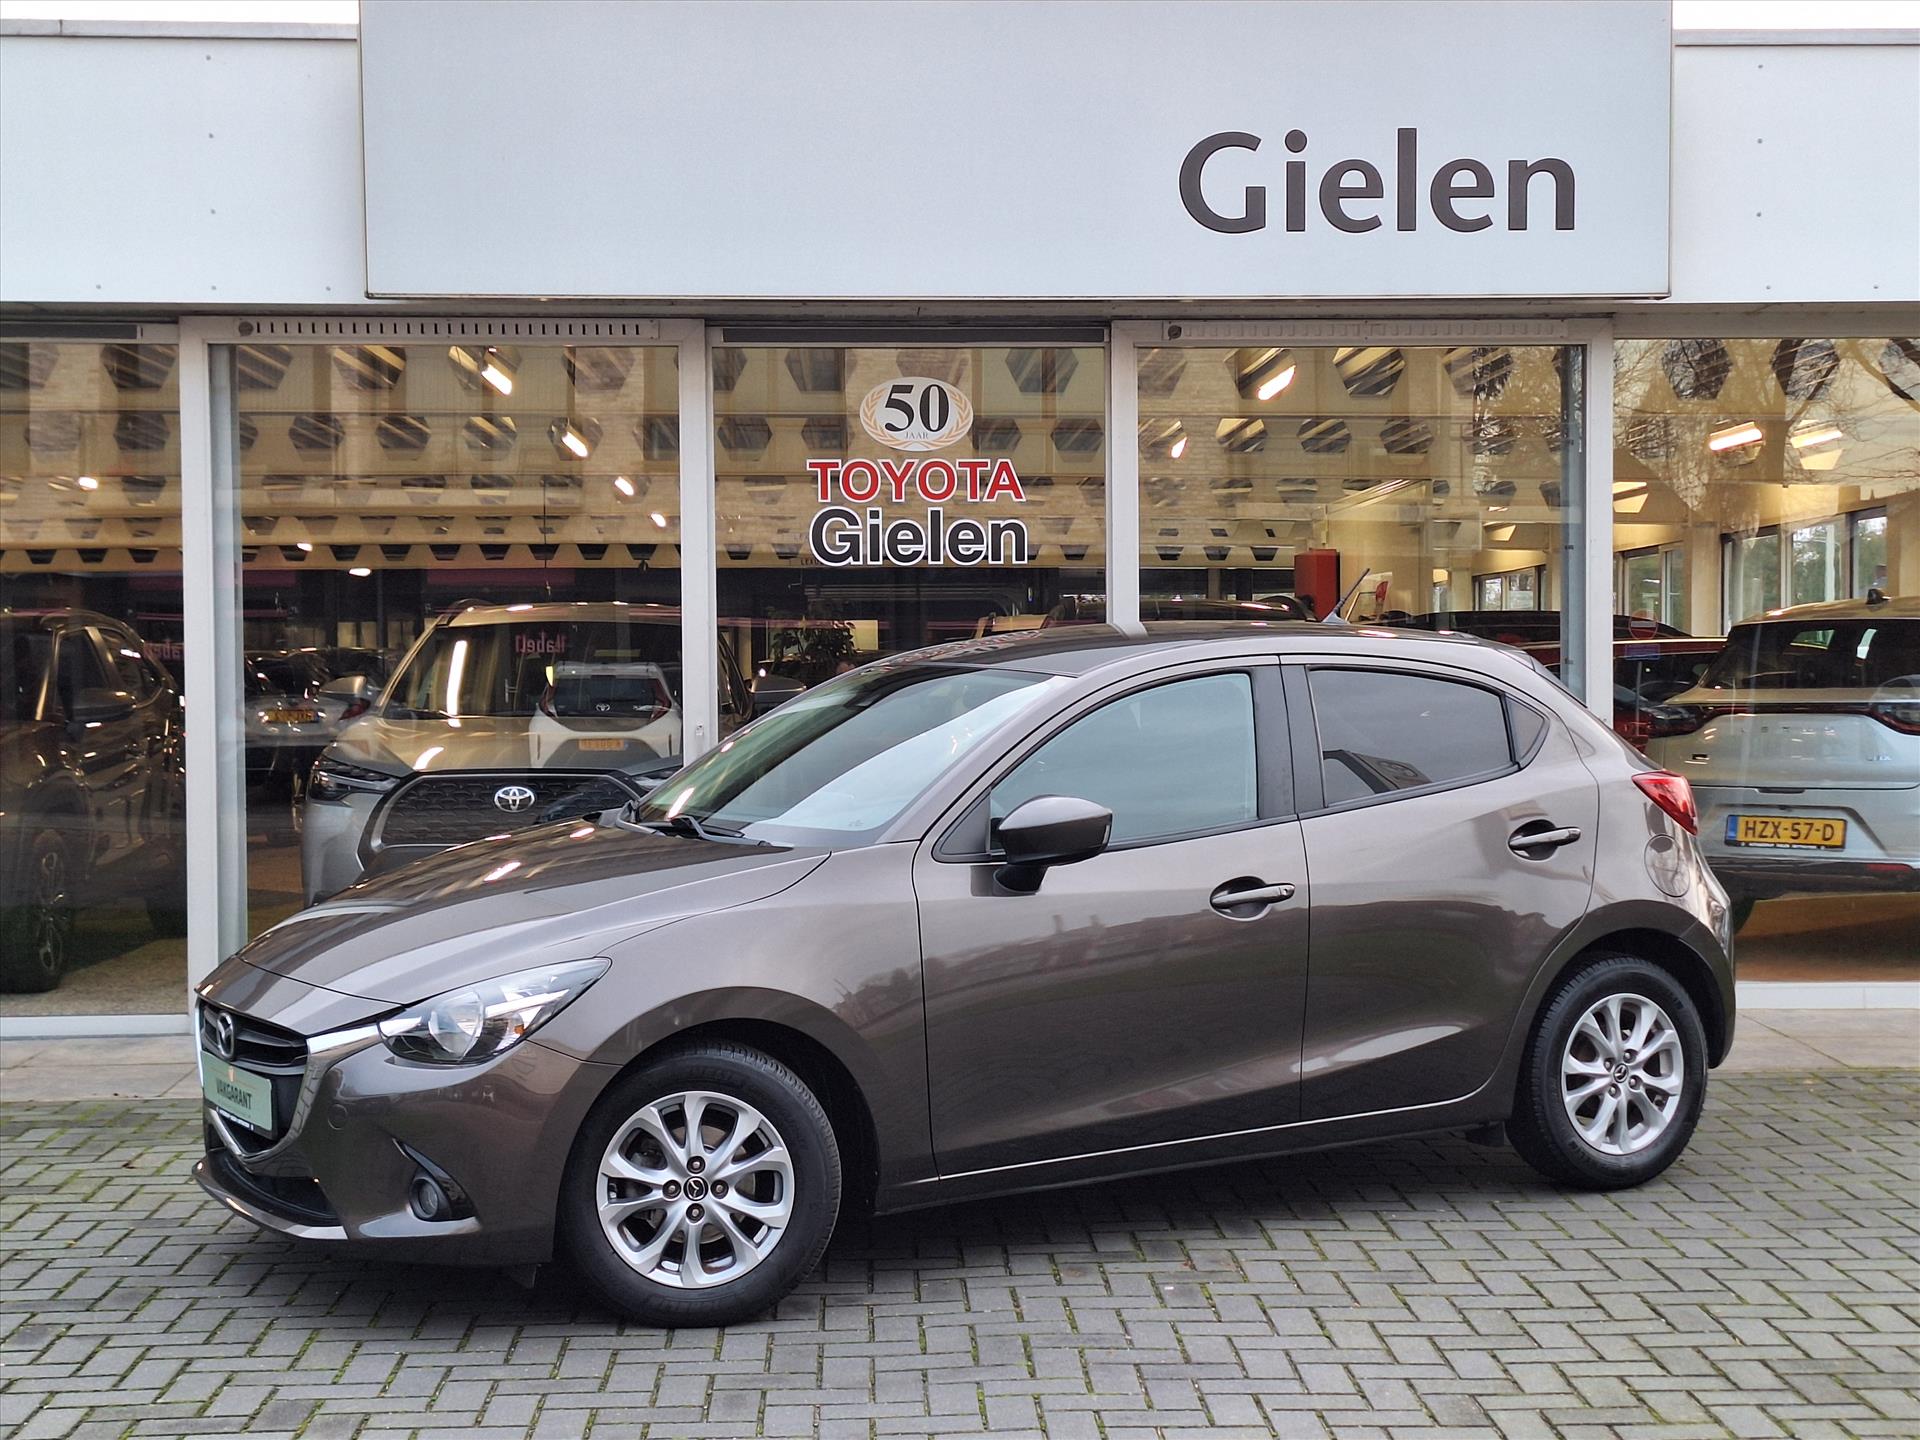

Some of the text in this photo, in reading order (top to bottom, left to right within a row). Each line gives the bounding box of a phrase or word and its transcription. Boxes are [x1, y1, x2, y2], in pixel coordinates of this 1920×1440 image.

[1178, 127, 1576, 234] Gielen
[884, 383, 950, 433] 50
[904, 431, 929, 440] JAAR
[807, 460, 1025, 502] TOYOTA
[810, 507, 1027, 565] Gielen
[1743, 819, 1836, 842] HZX-57-D
